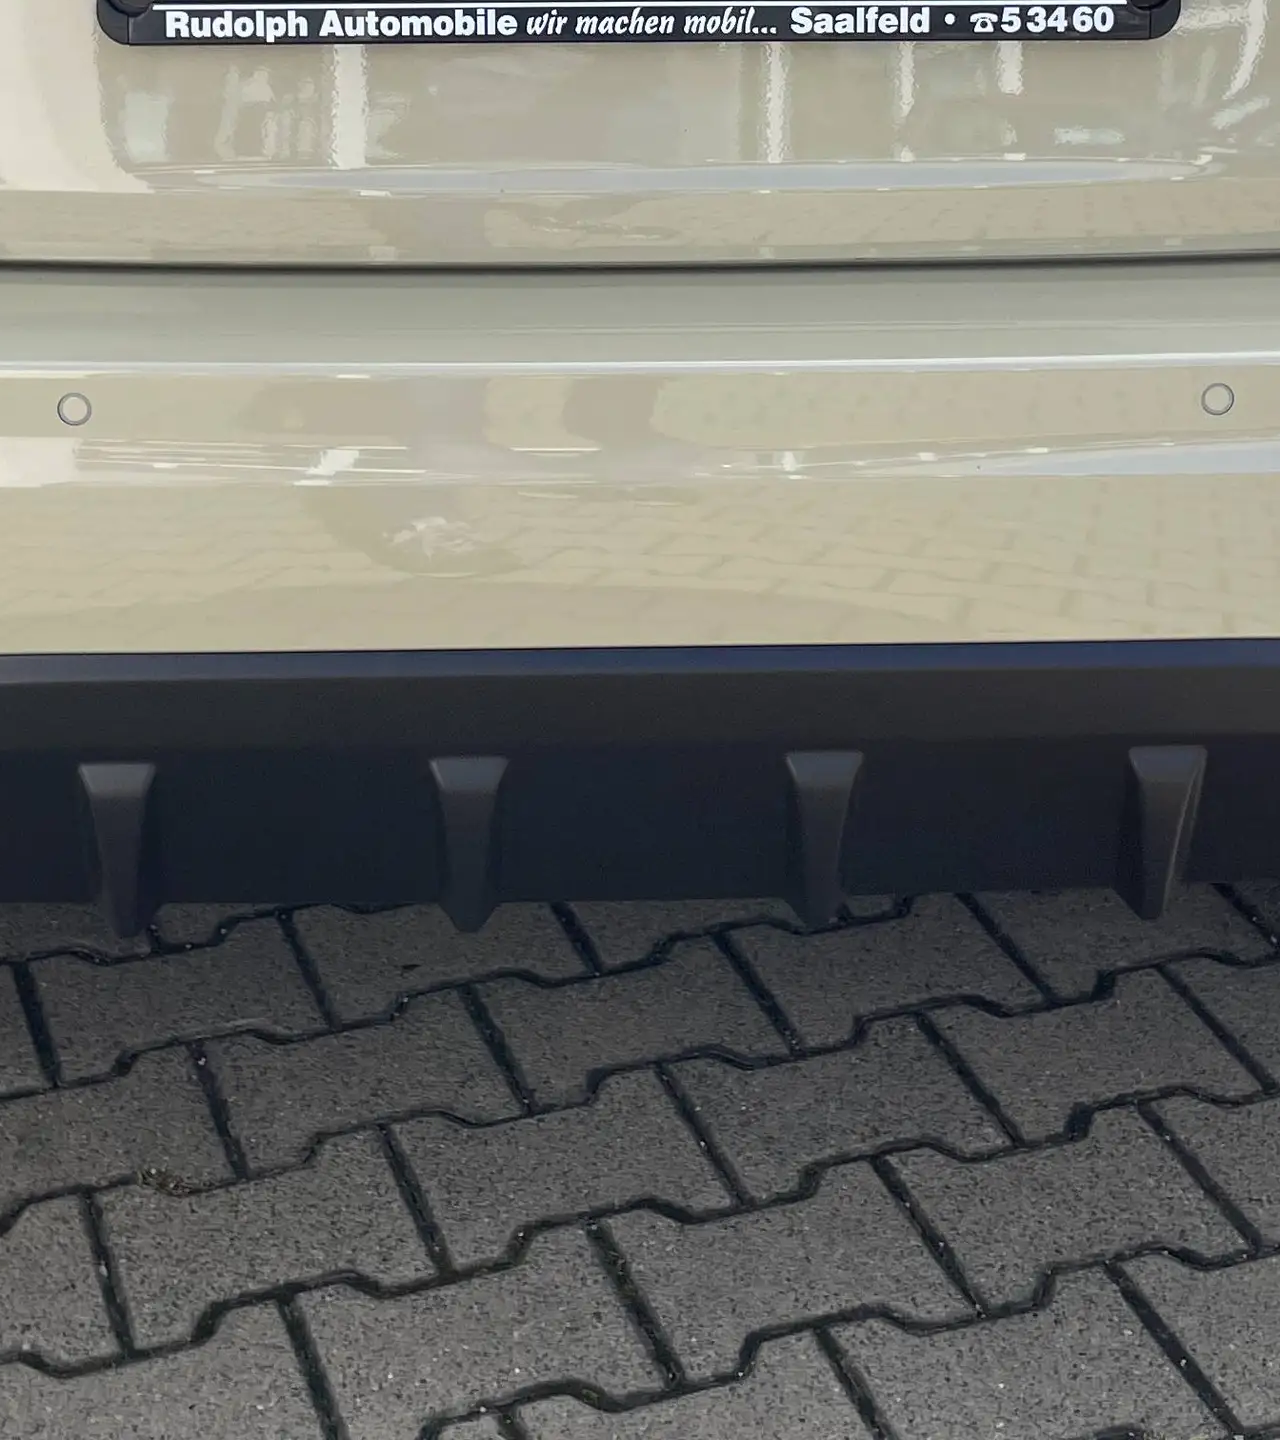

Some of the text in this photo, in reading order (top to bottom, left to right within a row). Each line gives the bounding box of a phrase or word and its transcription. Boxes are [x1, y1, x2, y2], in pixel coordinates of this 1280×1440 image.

[165, 10, 309, 43] Rudolph
[319, 9, 518, 37] Automobile
[526, 9, 569, 36] wir
[575, 7, 676, 36] machen
[683, 6, 778, 35] mobil...
[790, 6, 931, 34] Saalfeld
